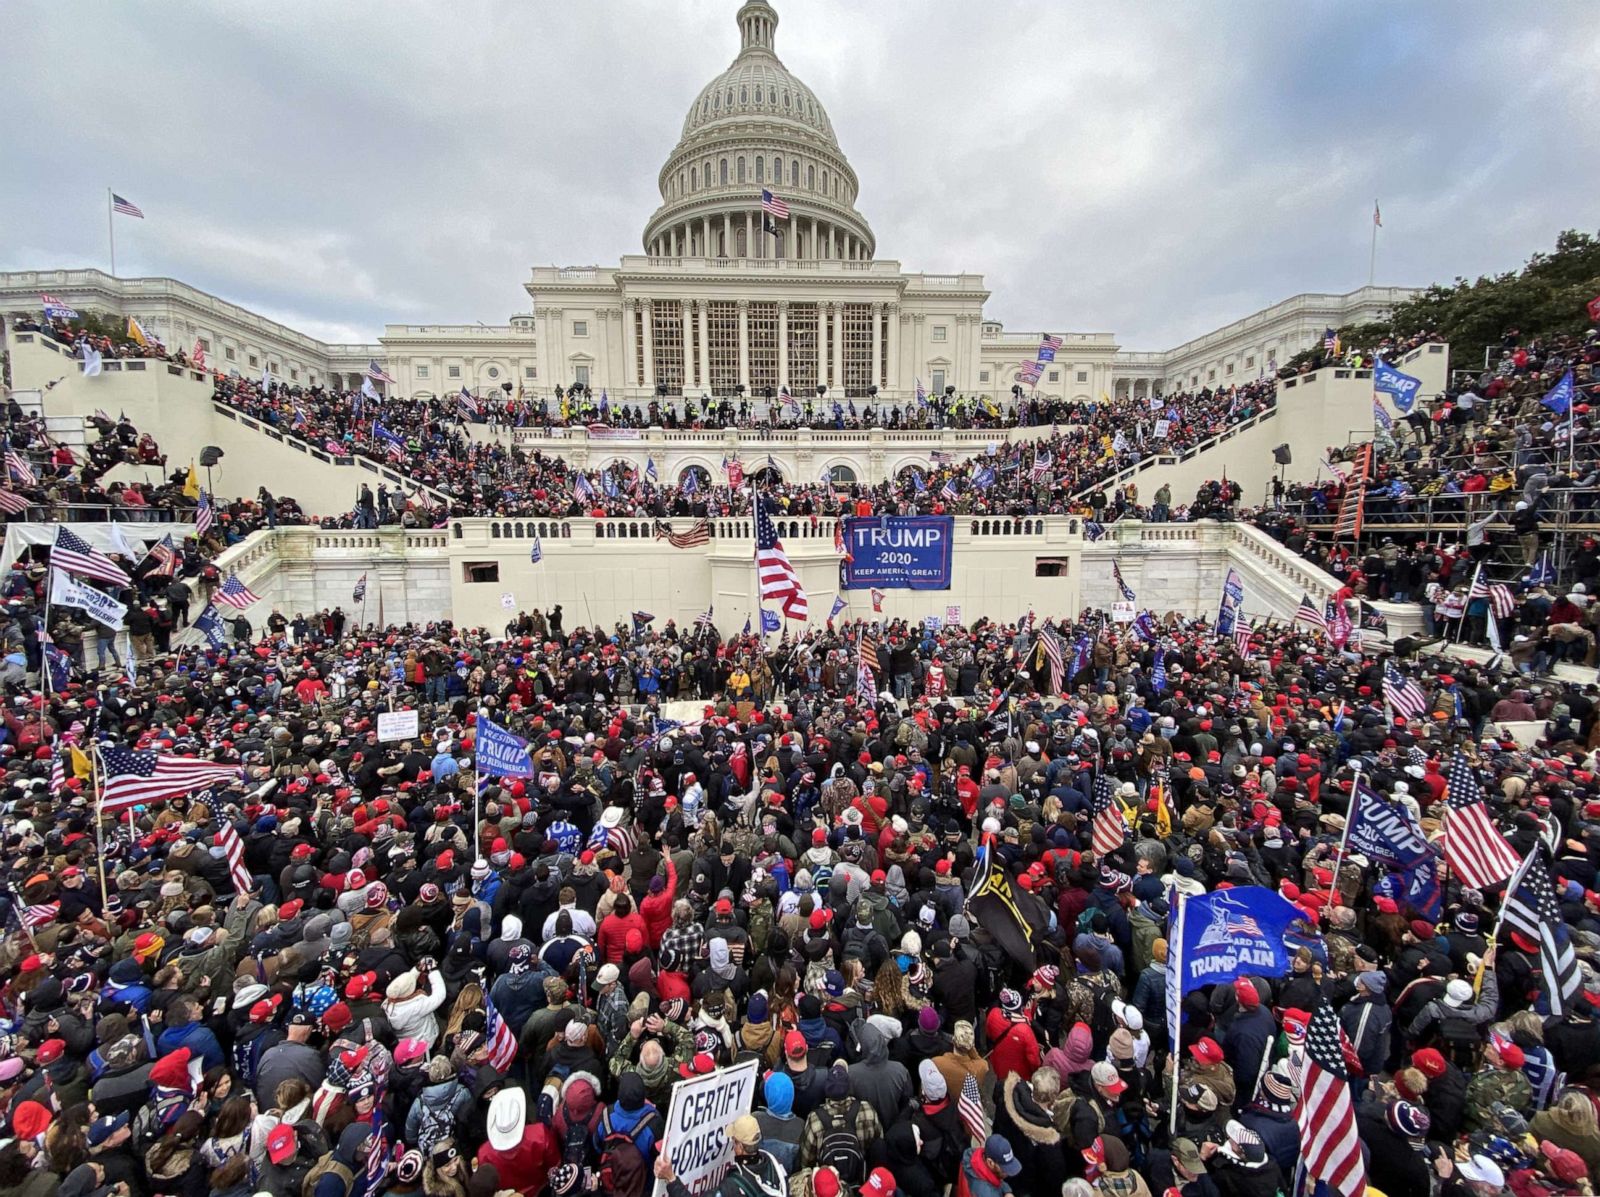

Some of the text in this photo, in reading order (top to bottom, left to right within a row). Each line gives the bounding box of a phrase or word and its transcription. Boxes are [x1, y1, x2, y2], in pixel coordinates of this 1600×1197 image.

[854, 527, 941, 547] TRUMP
[854, 568, 875, 576] KEEP
[877, 568, 910, 576] AMERICA
[88, 605, 117, 624] BULLSHIT
[479, 736, 526, 764] TRUMP
[1358, 789, 1426, 854] RUMP
[1190, 948, 1275, 978] TRUMP AIN
[680, 1077, 747, 1133] CERTIFY
